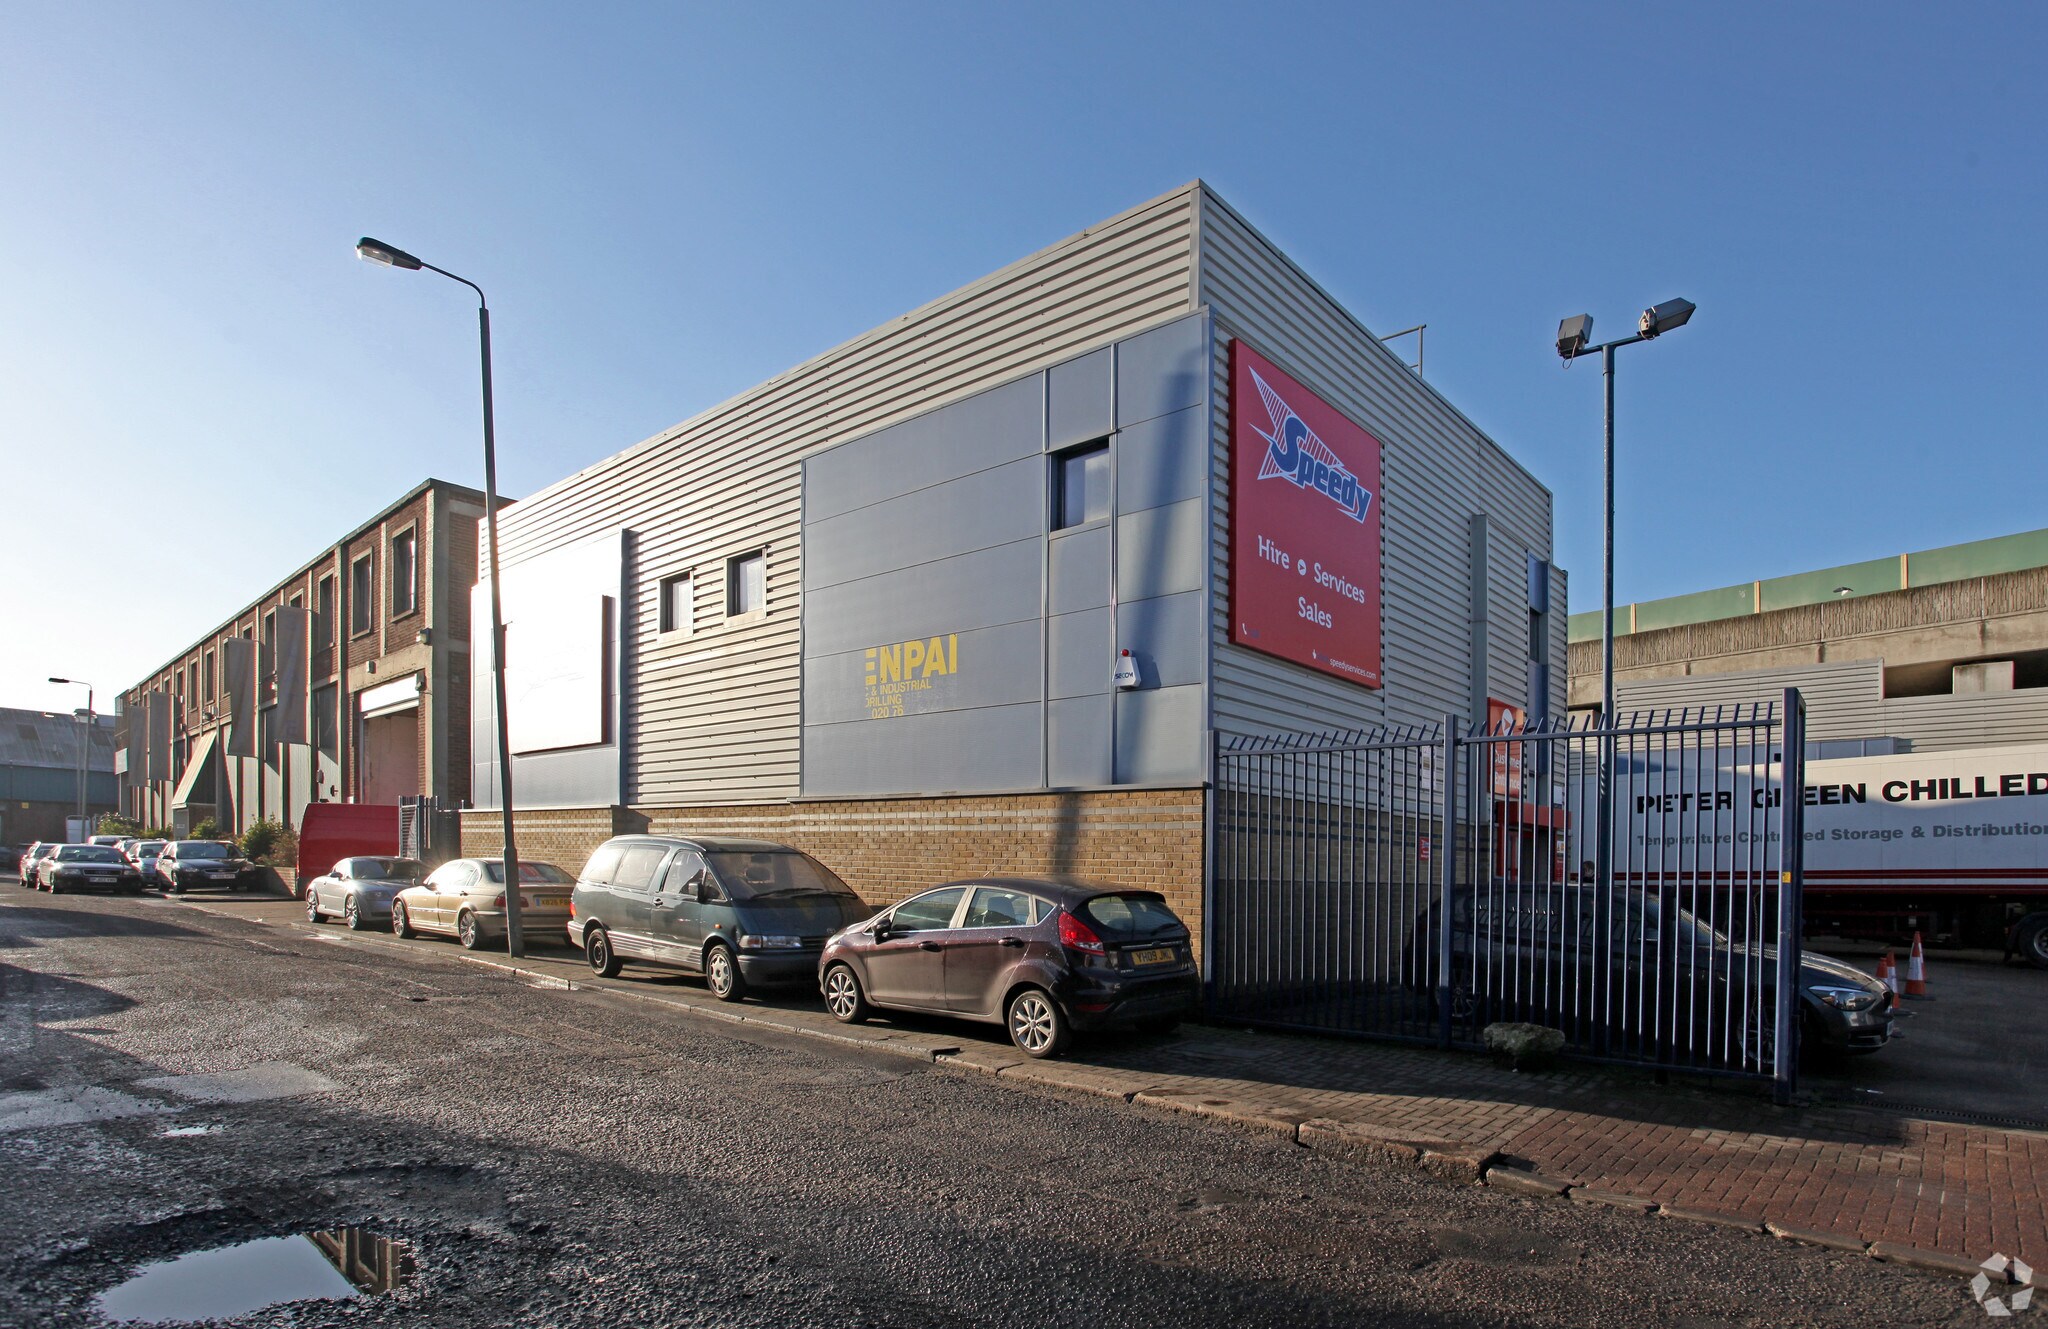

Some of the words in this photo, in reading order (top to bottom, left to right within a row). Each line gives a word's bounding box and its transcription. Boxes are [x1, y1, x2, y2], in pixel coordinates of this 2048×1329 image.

[1257, 535, 1290, 570] Hire
[1313, 562, 1366, 604] Services
[1298, 596, 1332, 629] Sales
[1329, 658, 1377, 680] speedyservices.com
[880, 678, 932, 695] INDUSTRIAL
[872, 706, 889, 719] 020
[1637, 791, 1732, 814] PETER
[1882, 773, 2048, 802] CHILLED
[1738, 829, 1825, 843] Conted
[1831, 827, 1903, 842] Storage
[1911, 825, 1925, 838] &
